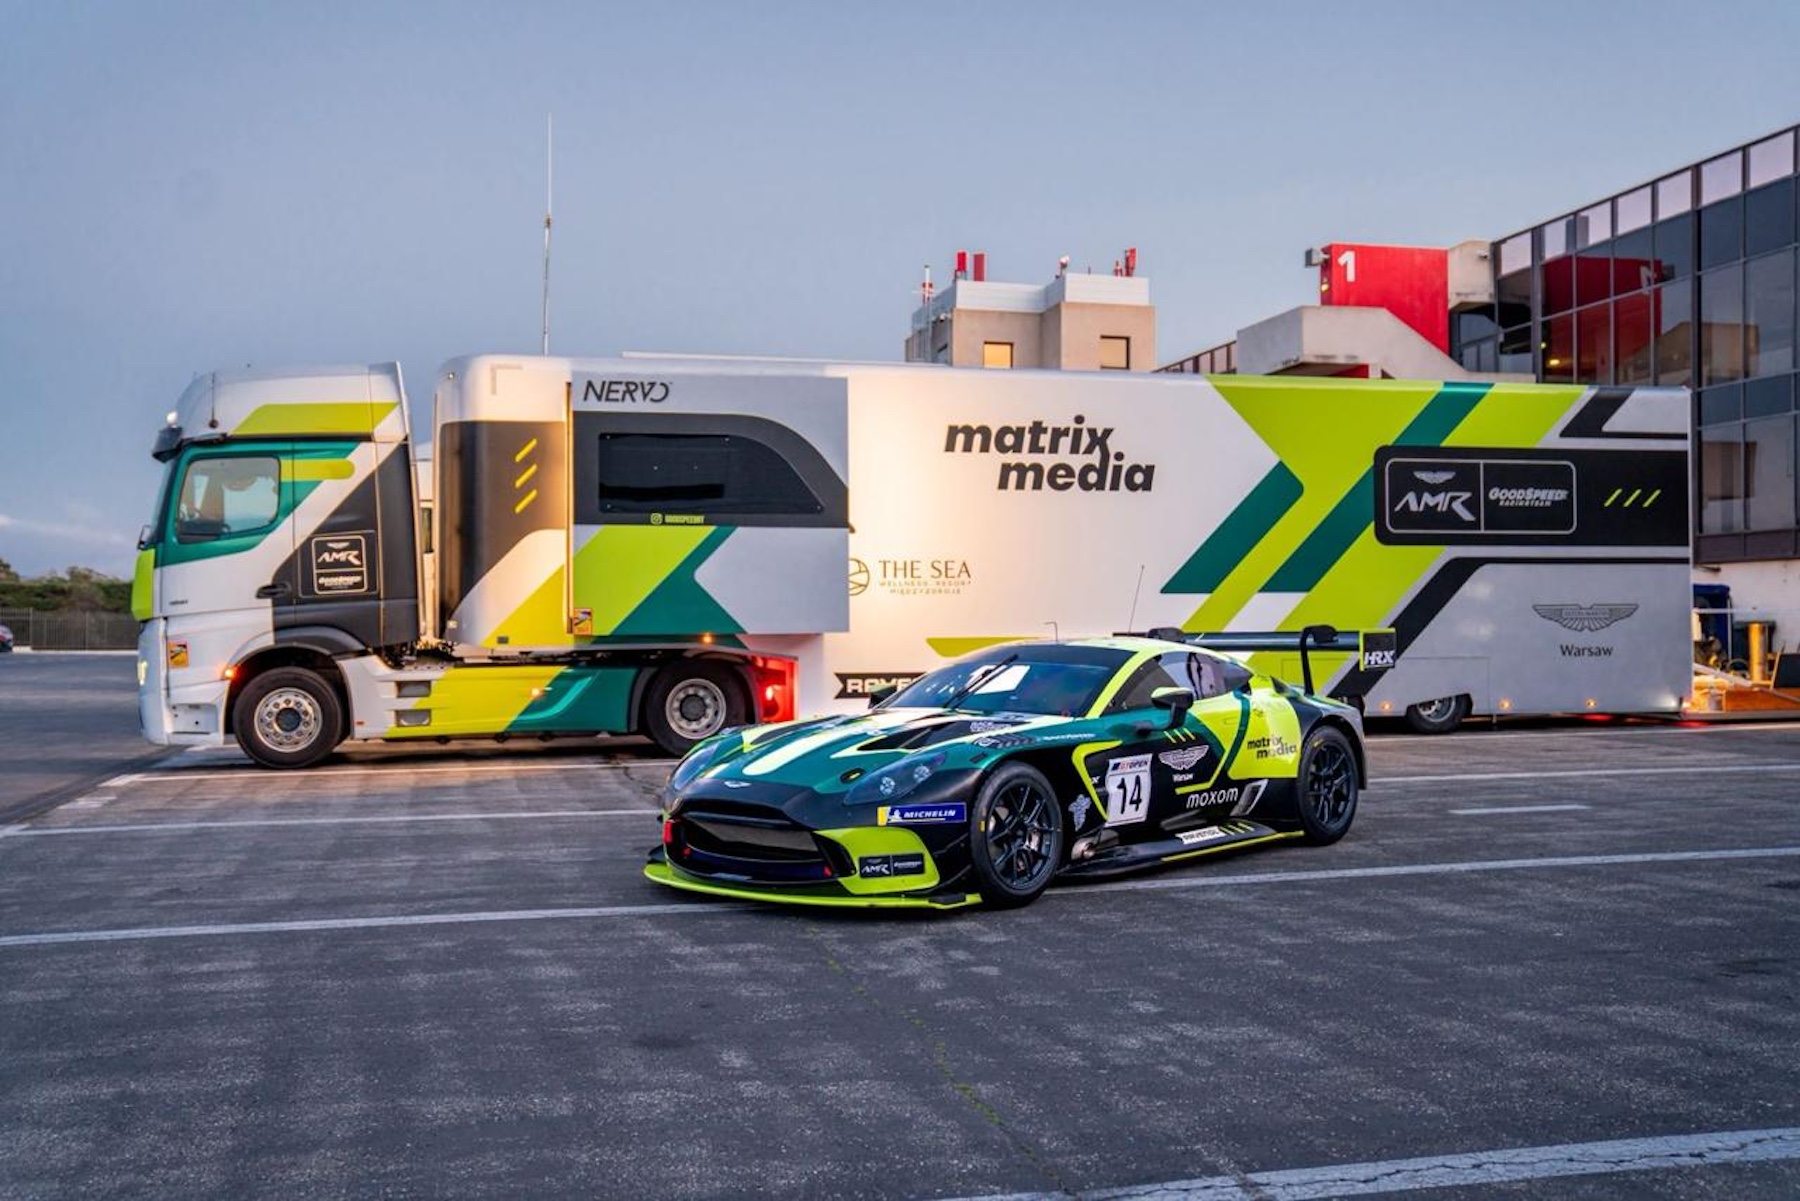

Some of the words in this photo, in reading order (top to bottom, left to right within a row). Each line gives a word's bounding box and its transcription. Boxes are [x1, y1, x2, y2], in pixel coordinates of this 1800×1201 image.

[1337, 250, 1356, 282] 1
[944, 414, 1115, 455] matrix
[997, 450, 1156, 492] media
[1394, 491, 1476, 521] AMR
[878, 560, 922, 579] THE
[930, 560, 972, 579] SEA
[1363, 650, 1395, 666] HRX
[1560, 644, 1614, 657] Warsaw
[846, 678, 914, 693] RAVE
[1116, 774, 1142, 815] 14
[1186, 787, 1239, 809] moxom
[903, 809, 956, 818] MICHELIN
